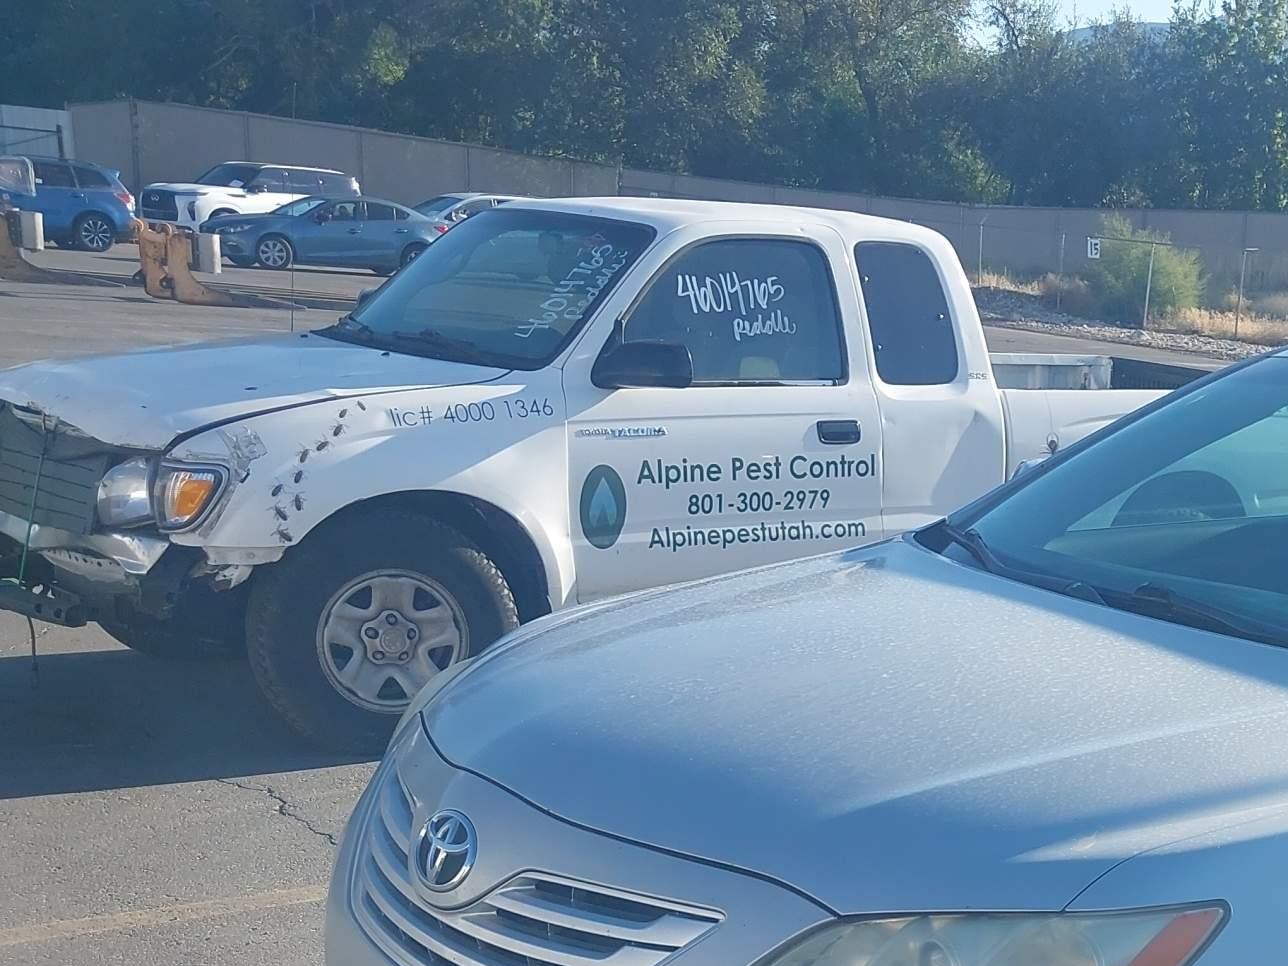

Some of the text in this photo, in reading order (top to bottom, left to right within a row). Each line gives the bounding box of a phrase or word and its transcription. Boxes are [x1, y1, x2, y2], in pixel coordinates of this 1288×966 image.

[1090, 241, 1099, 256] 15
[514, 244, 613, 338] 46014765
[677, 271, 784, 315] 46014765
[389, 398, 554, 427] lic# 4000 1346
[637, 453, 876, 489] Alpine Pest Control
[687, 489, 831, 515] 801-300-2979
[648, 520, 866, 552] Alpinepestutah.com
